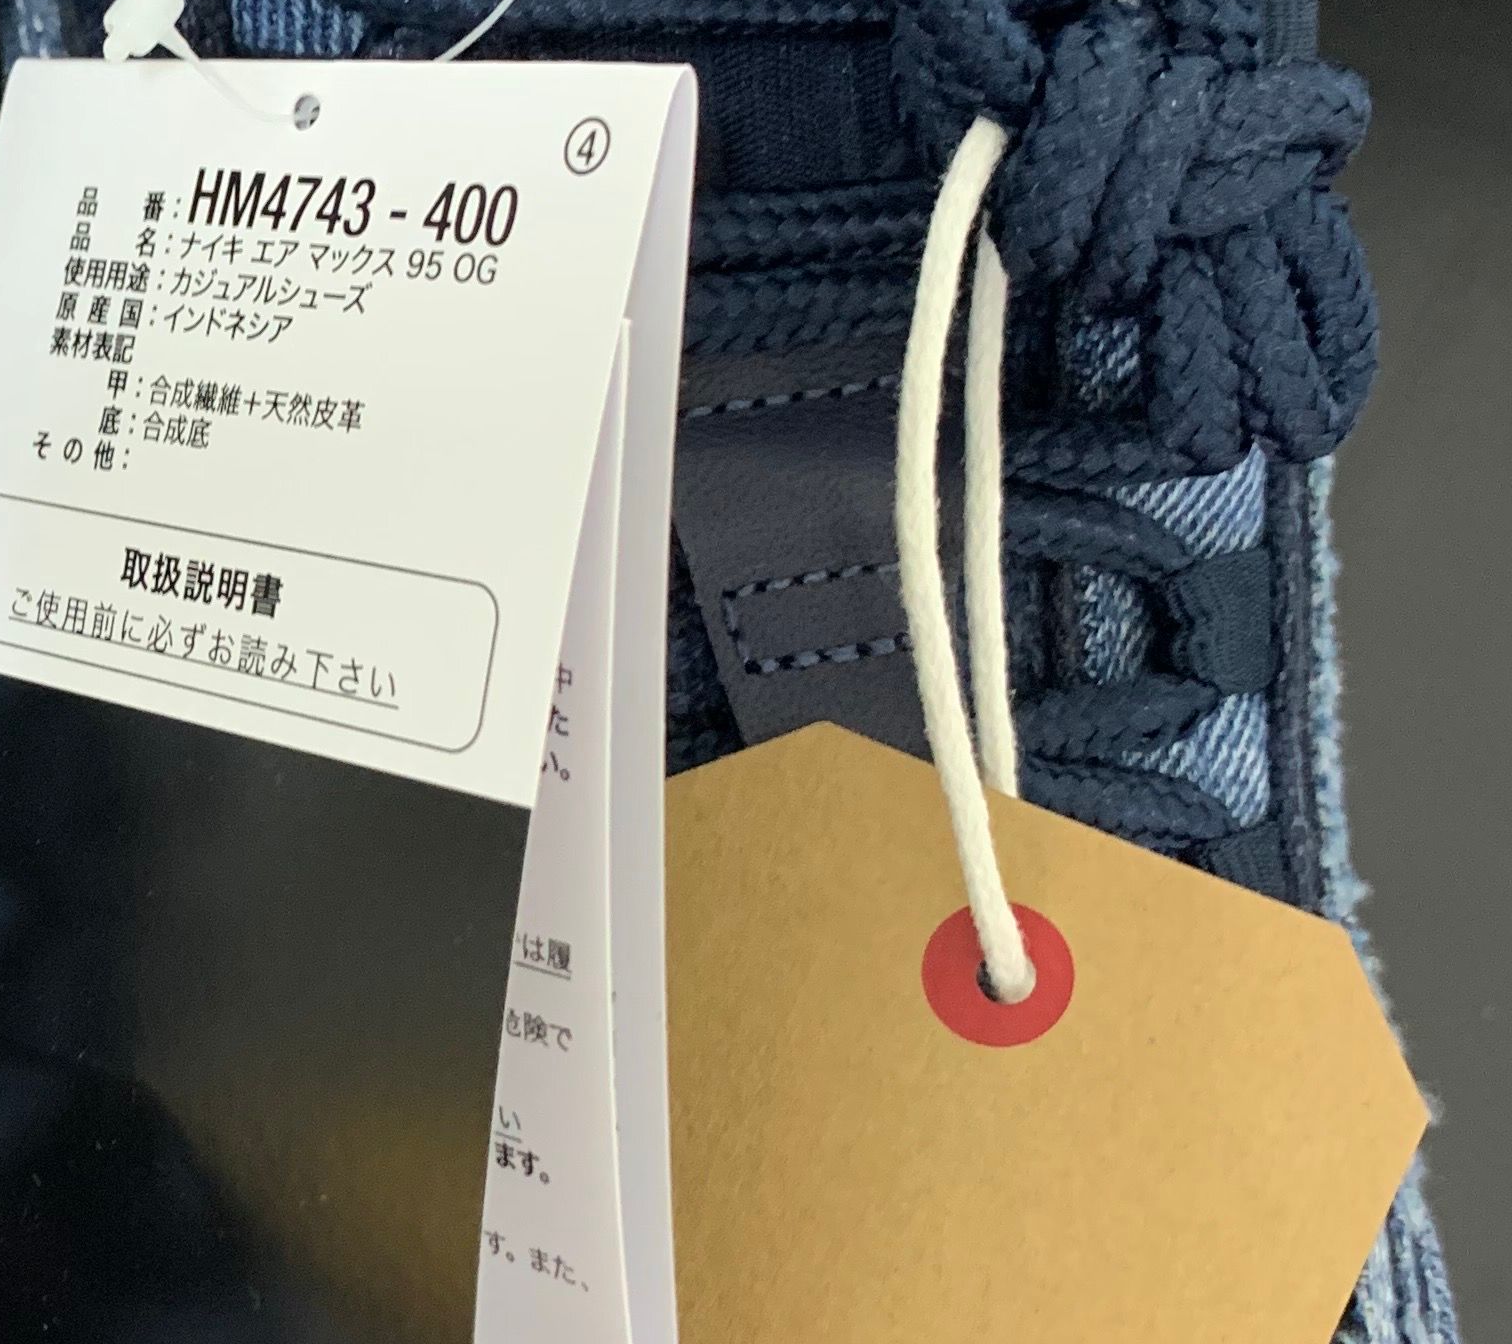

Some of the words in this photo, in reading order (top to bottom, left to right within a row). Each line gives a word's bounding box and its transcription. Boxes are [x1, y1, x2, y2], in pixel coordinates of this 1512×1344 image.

[49, 327, 136, 364] 素材表記
[120, 547, 283, 619] 取扱説明書
[9, 587, 397, 699] ご使用前に必ずお読み下さい
